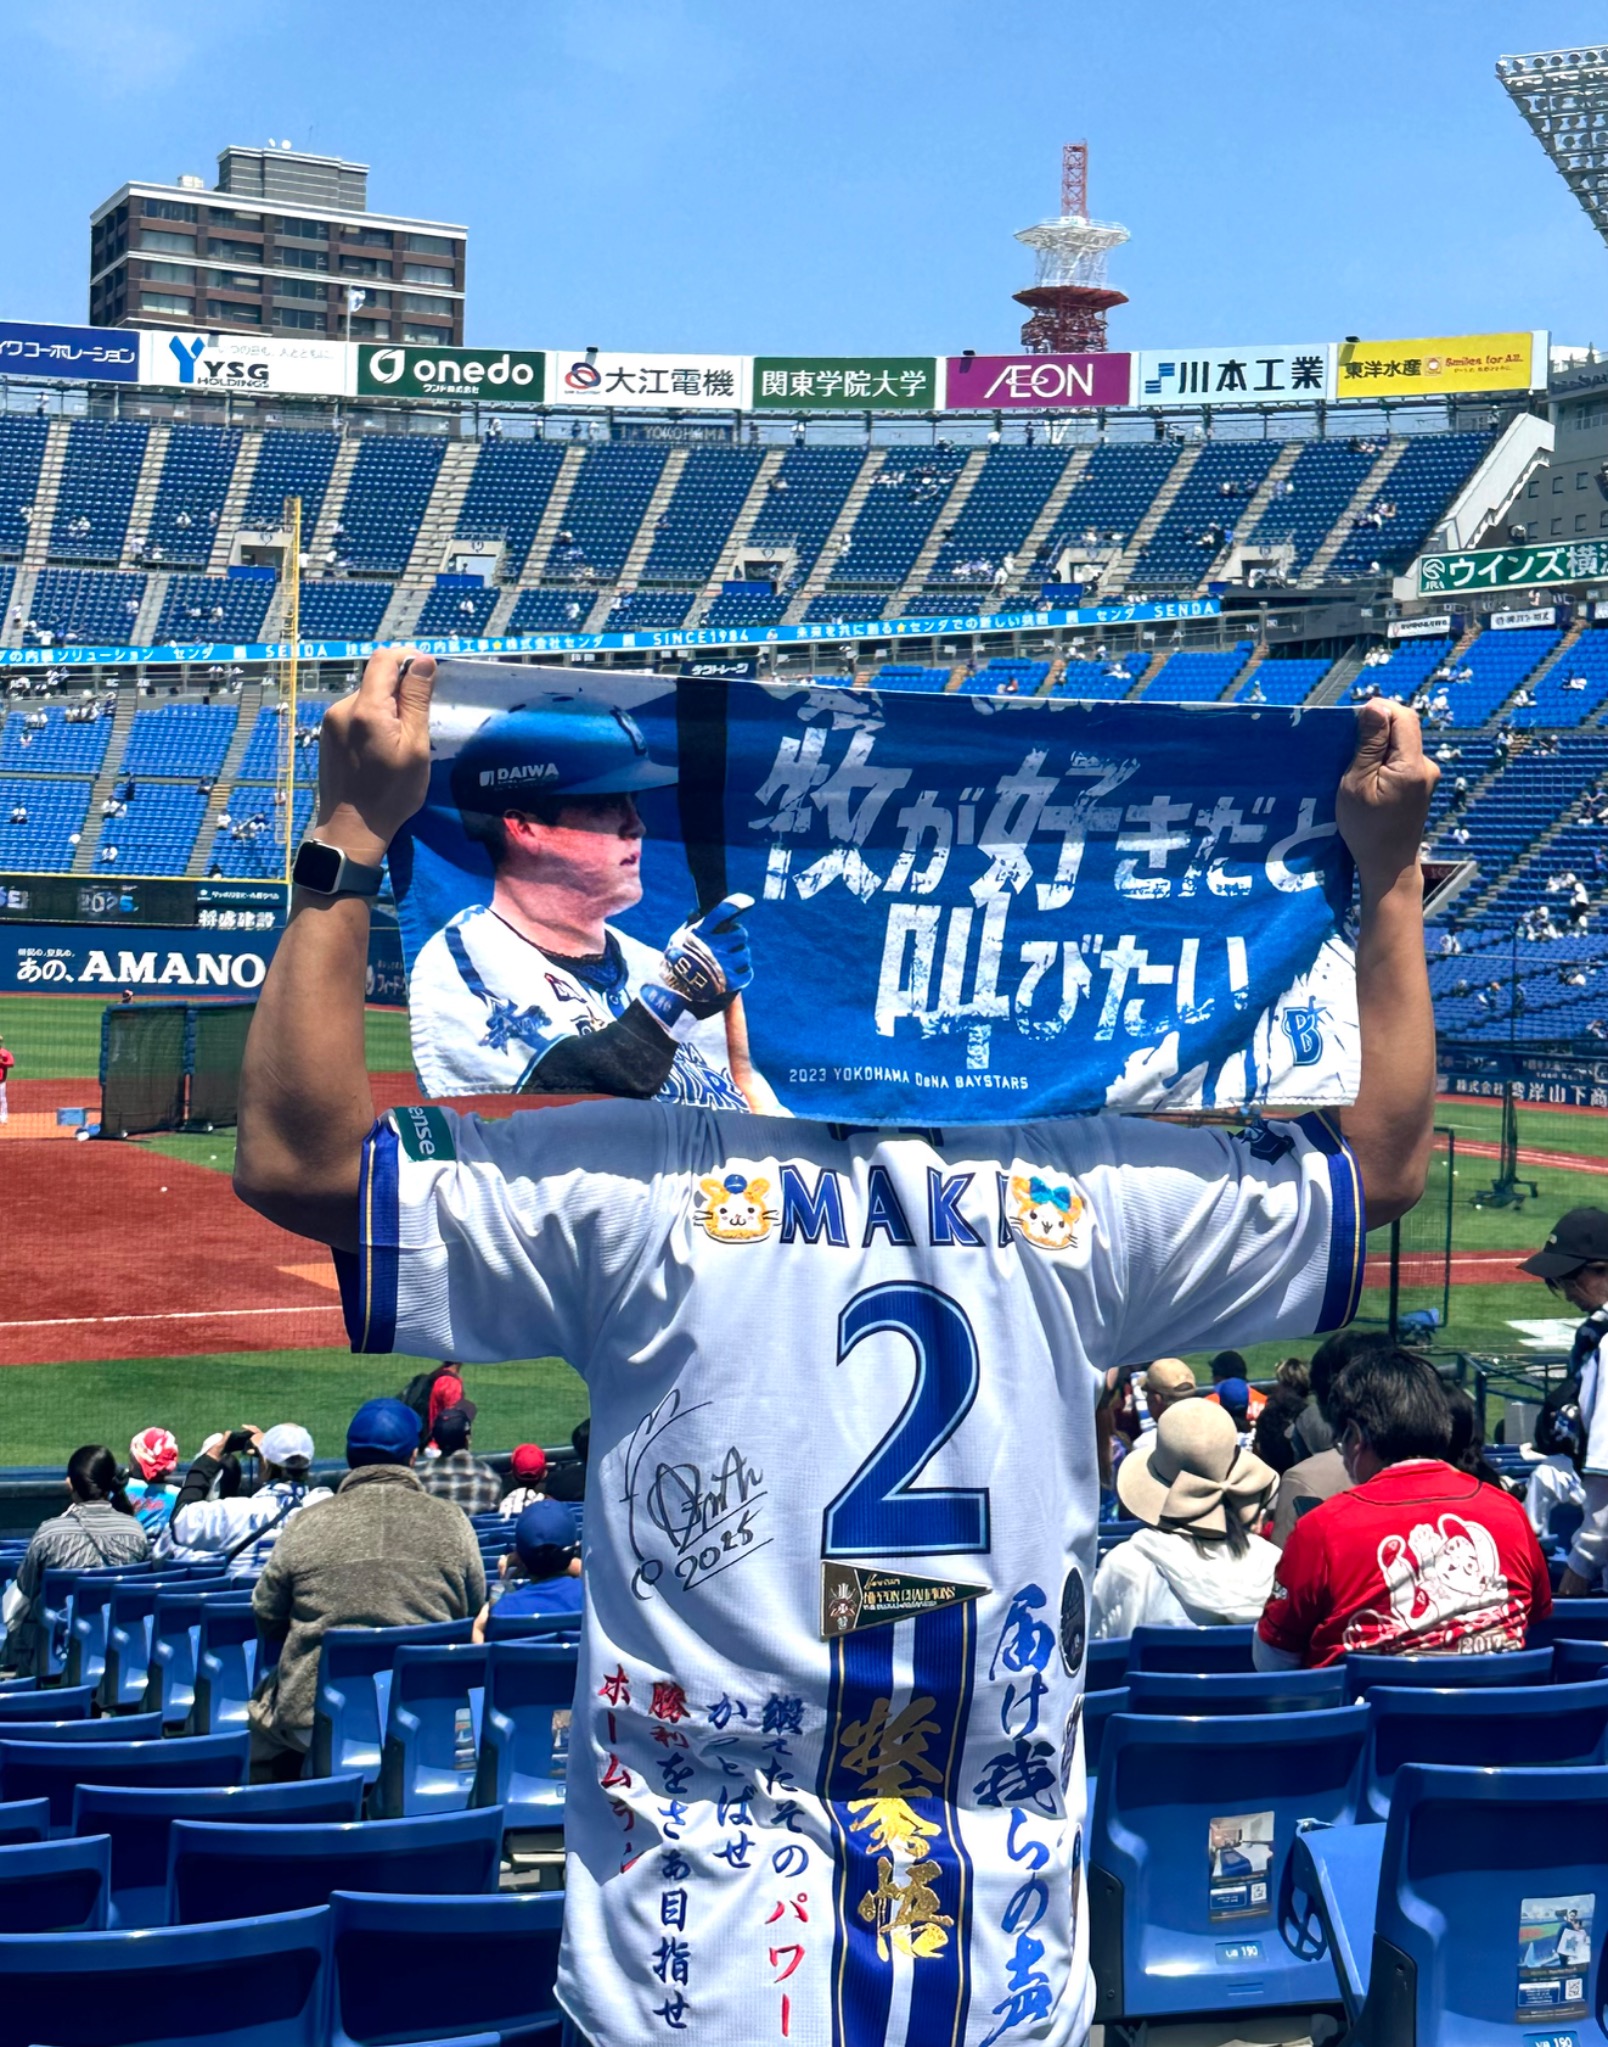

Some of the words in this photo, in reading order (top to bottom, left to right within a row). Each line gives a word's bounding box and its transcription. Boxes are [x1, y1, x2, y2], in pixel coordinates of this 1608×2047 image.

[203, 361, 270, 380] YSG
[413, 354, 534, 386] onedo
[1178, 356, 1324, 394] 川本工業
[1344, 359, 1421, 379] 東洋水産
[1486, 355, 1503, 365] for
[197, 376, 270, 388] HOLDINGS
[605, 367, 735, 397] 大江電機
[762, 369, 927, 397] 関東学院大学
[1424, 581, 1445, 590] JRA
[173, 645, 214, 660] センダ
[1097, 606, 1136, 621] センダ
[1154, 601, 1215, 619] SENDA
[497, 762, 559, 780] DAIWA
[748, 726, 1338, 911] 牧が好きだと
[17, 957, 75, 983] あの、
[78, 950, 267, 989] AMANO
[874, 892, 1249, 1070] 叫びたい
[788, 1068, 827, 1083] 2023
[833, 1066, 910, 1084] YOKOHAMA
[915, 1072, 949, 1089] DeNA
[955, 1074, 1029, 1090] BAYSTARS
[820, 1279, 991, 1560] 2
[598, 1663, 644, 1876] ホームラン
[649, 1680, 697, 2030] 勝利をさあ目指せ
